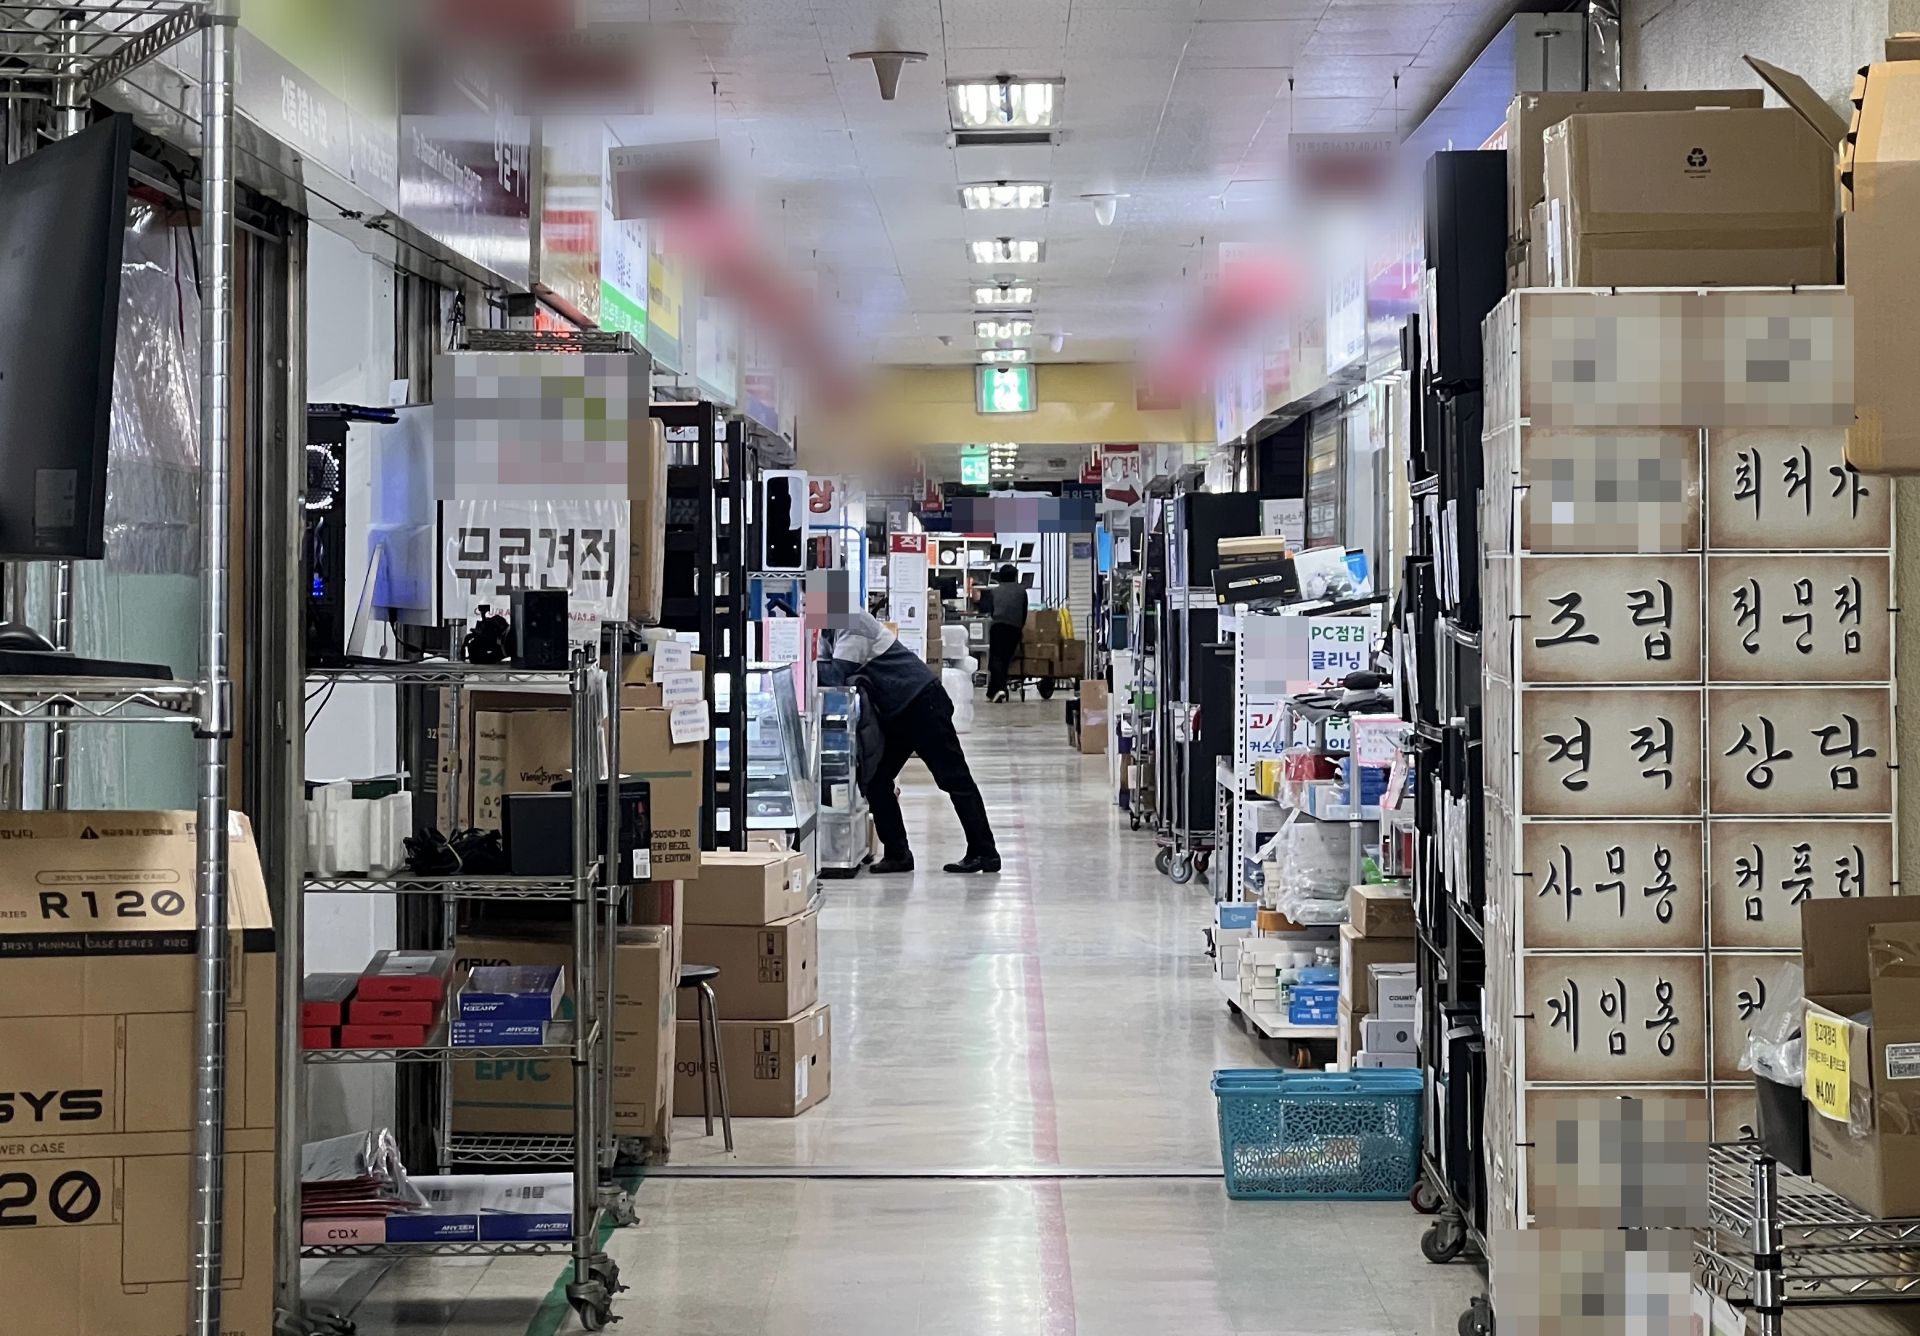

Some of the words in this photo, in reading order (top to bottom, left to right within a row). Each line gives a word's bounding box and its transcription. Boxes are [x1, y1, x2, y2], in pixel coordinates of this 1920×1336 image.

[1733, 445, 1869, 521] 최저가
[454, 527, 616, 598] 무료견적
[1535, 578, 1673, 661] 조립
[1732, 577, 1862, 655] 전문점
[1312, 626, 1365, 642] PC점검
[1311, 650, 1361, 670] 클리닝
[1543, 715, 1674, 791] 견적
[1724, 714, 1877, 791] 상담
[478, 767, 505, 786] 24
[520, 768, 563, 784] ViewSync
[1538, 843, 1678, 924] 사무용
[1733, 843, 1866, 922] 컴퓨터
[0, 910, 27, 918] RIES
[118, 939, 153, 948] SERIES
[1546, 977, 1679, 1057] 게임용
[475, 1060, 551, 1082] EPIC
[30, 1142, 65, 1154] CASE
